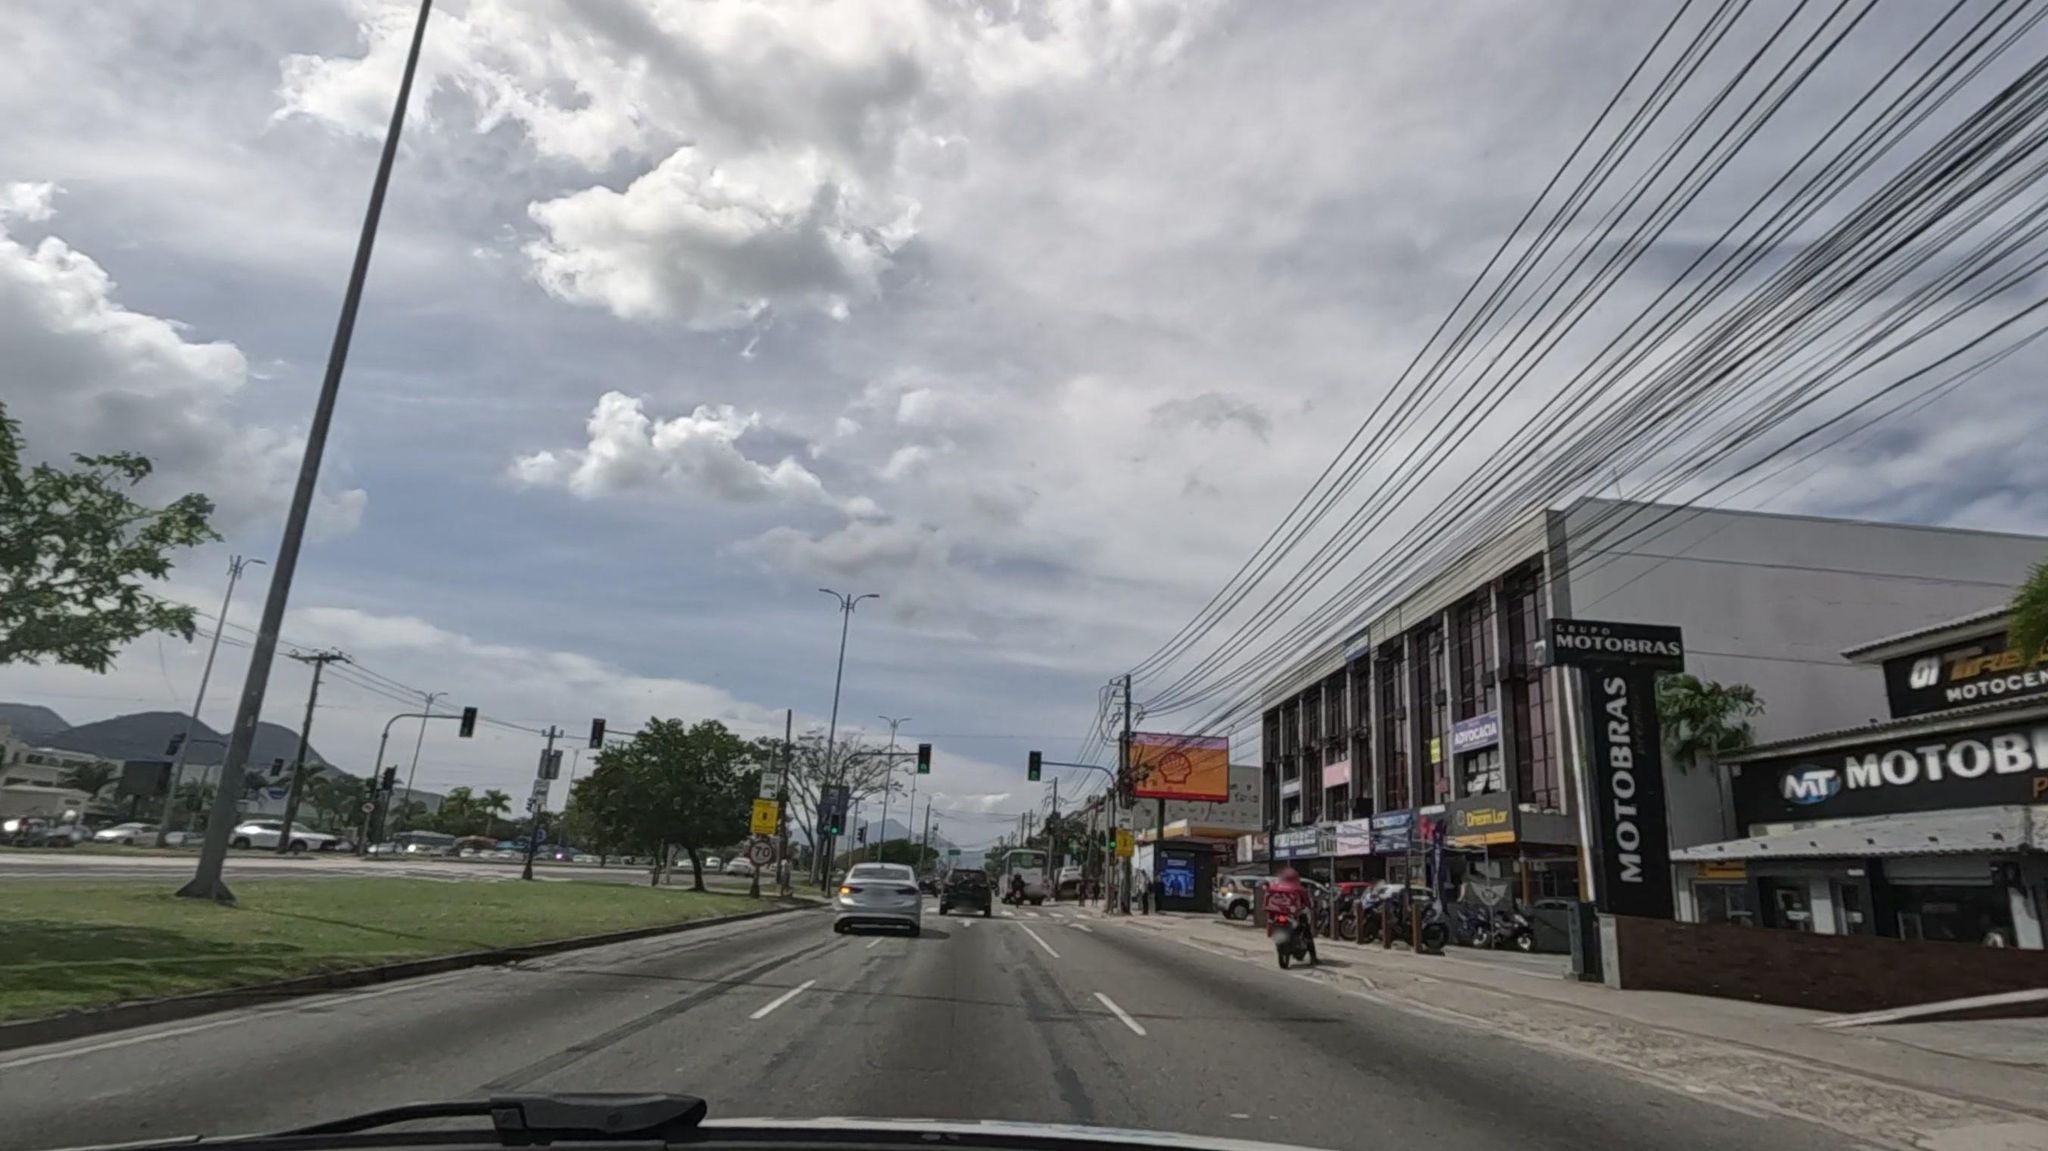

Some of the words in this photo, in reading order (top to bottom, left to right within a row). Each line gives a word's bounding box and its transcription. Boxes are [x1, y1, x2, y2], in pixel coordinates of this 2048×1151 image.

[1556, 624, 1611, 636] GRUPO
[1556, 635, 1681, 656] MOTOBRAS
[1603, 676, 1643, 884] MOTOBRAS
[1784, 769, 1837, 799] MT
[754, 846, 770, 858] 70
